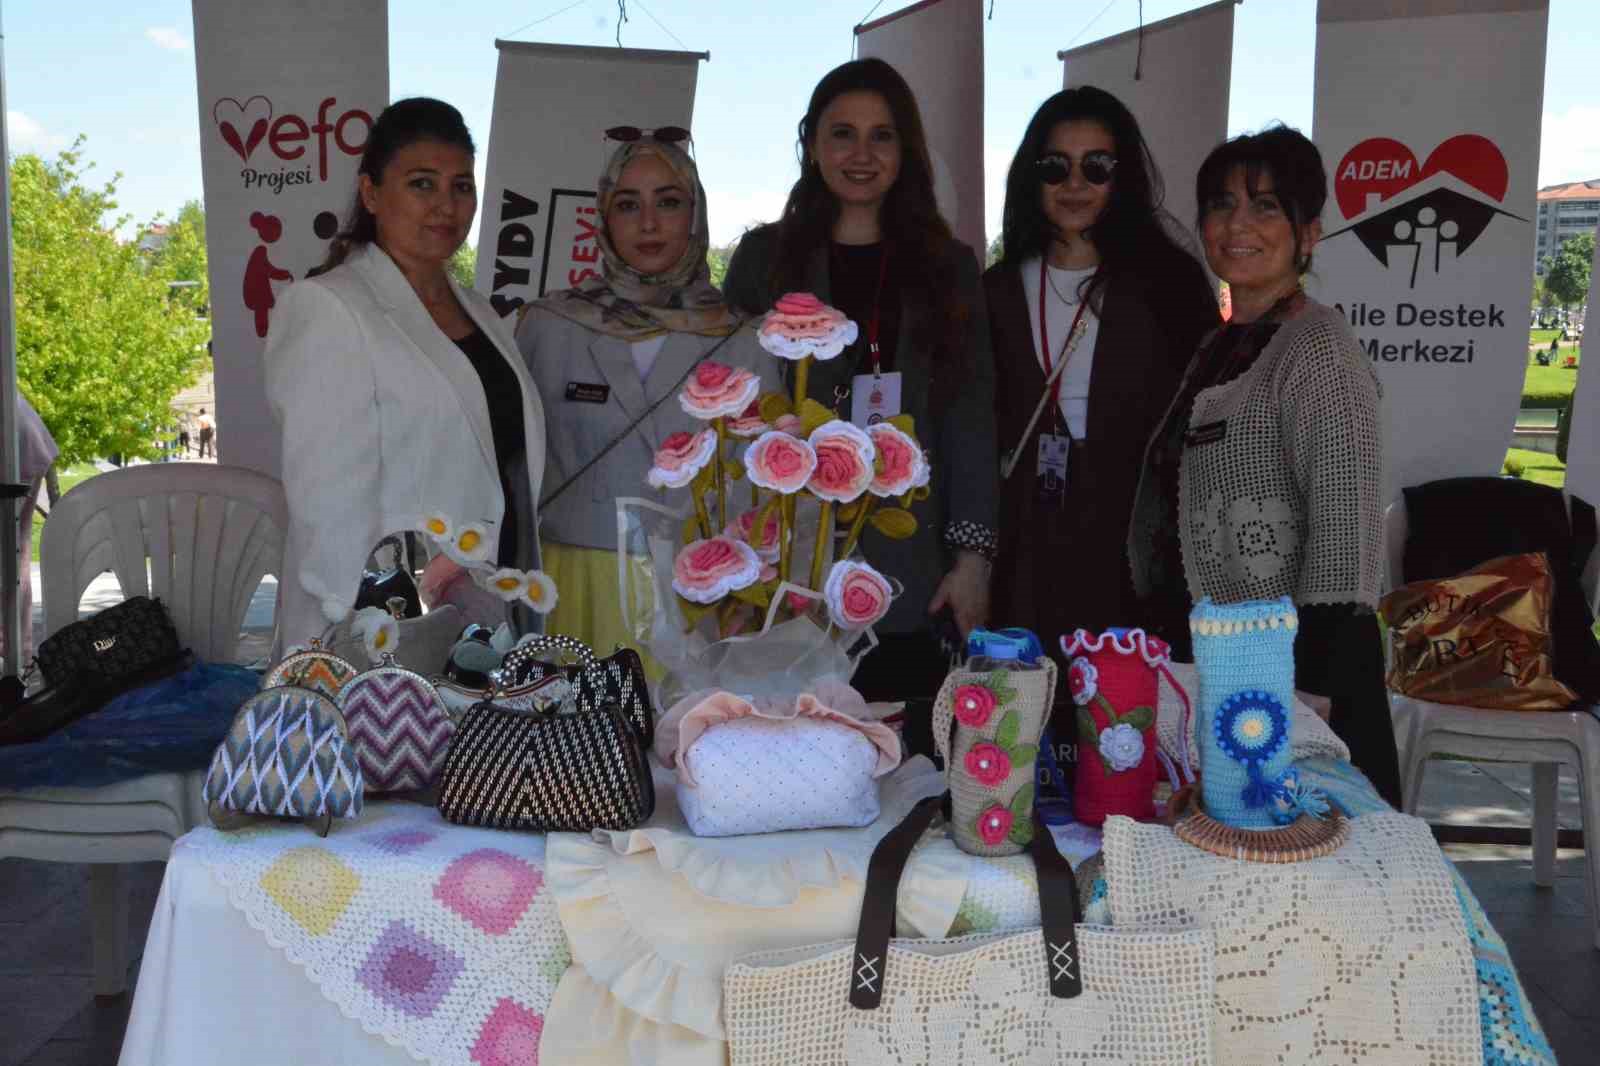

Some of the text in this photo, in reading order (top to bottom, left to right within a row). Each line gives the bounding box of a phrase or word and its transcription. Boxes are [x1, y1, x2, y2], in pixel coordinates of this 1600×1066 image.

[241, 165, 312, 194] Projesi
[1341, 159, 1412, 181] ADEM
[1335, 303, 1505, 327] ile Destek
[1360, 338, 1474, 362] Merkezi
